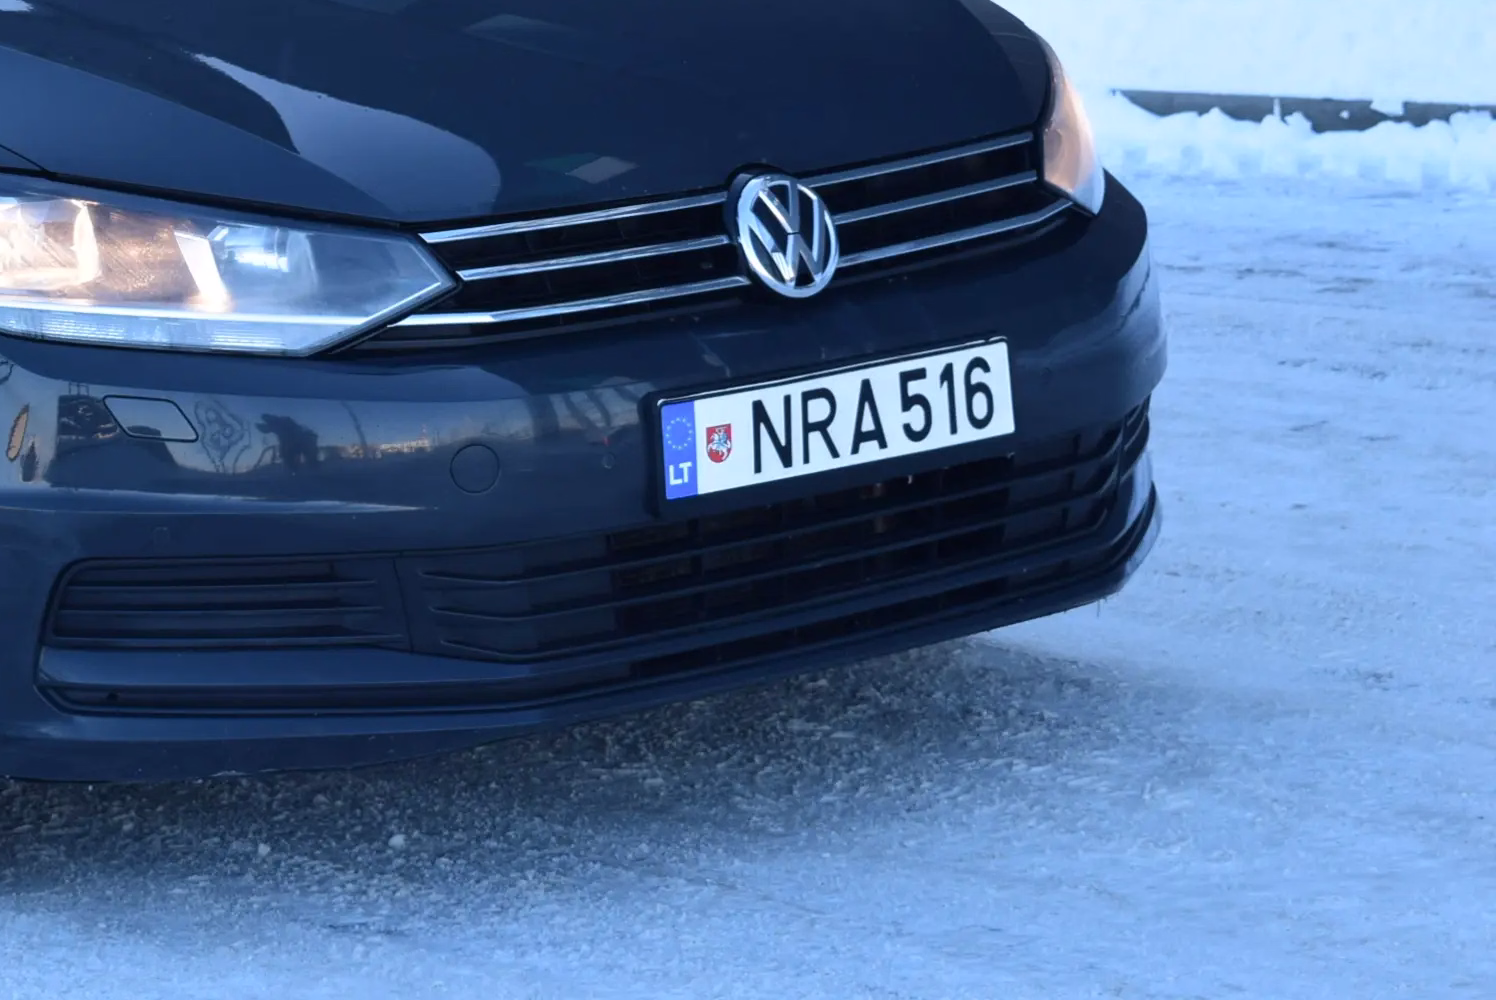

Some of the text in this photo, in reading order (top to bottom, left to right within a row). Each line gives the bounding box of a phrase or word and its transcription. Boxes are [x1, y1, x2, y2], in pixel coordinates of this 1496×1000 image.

[751, 356, 995, 474] NRA 516
[669, 461, 692, 485] LT
